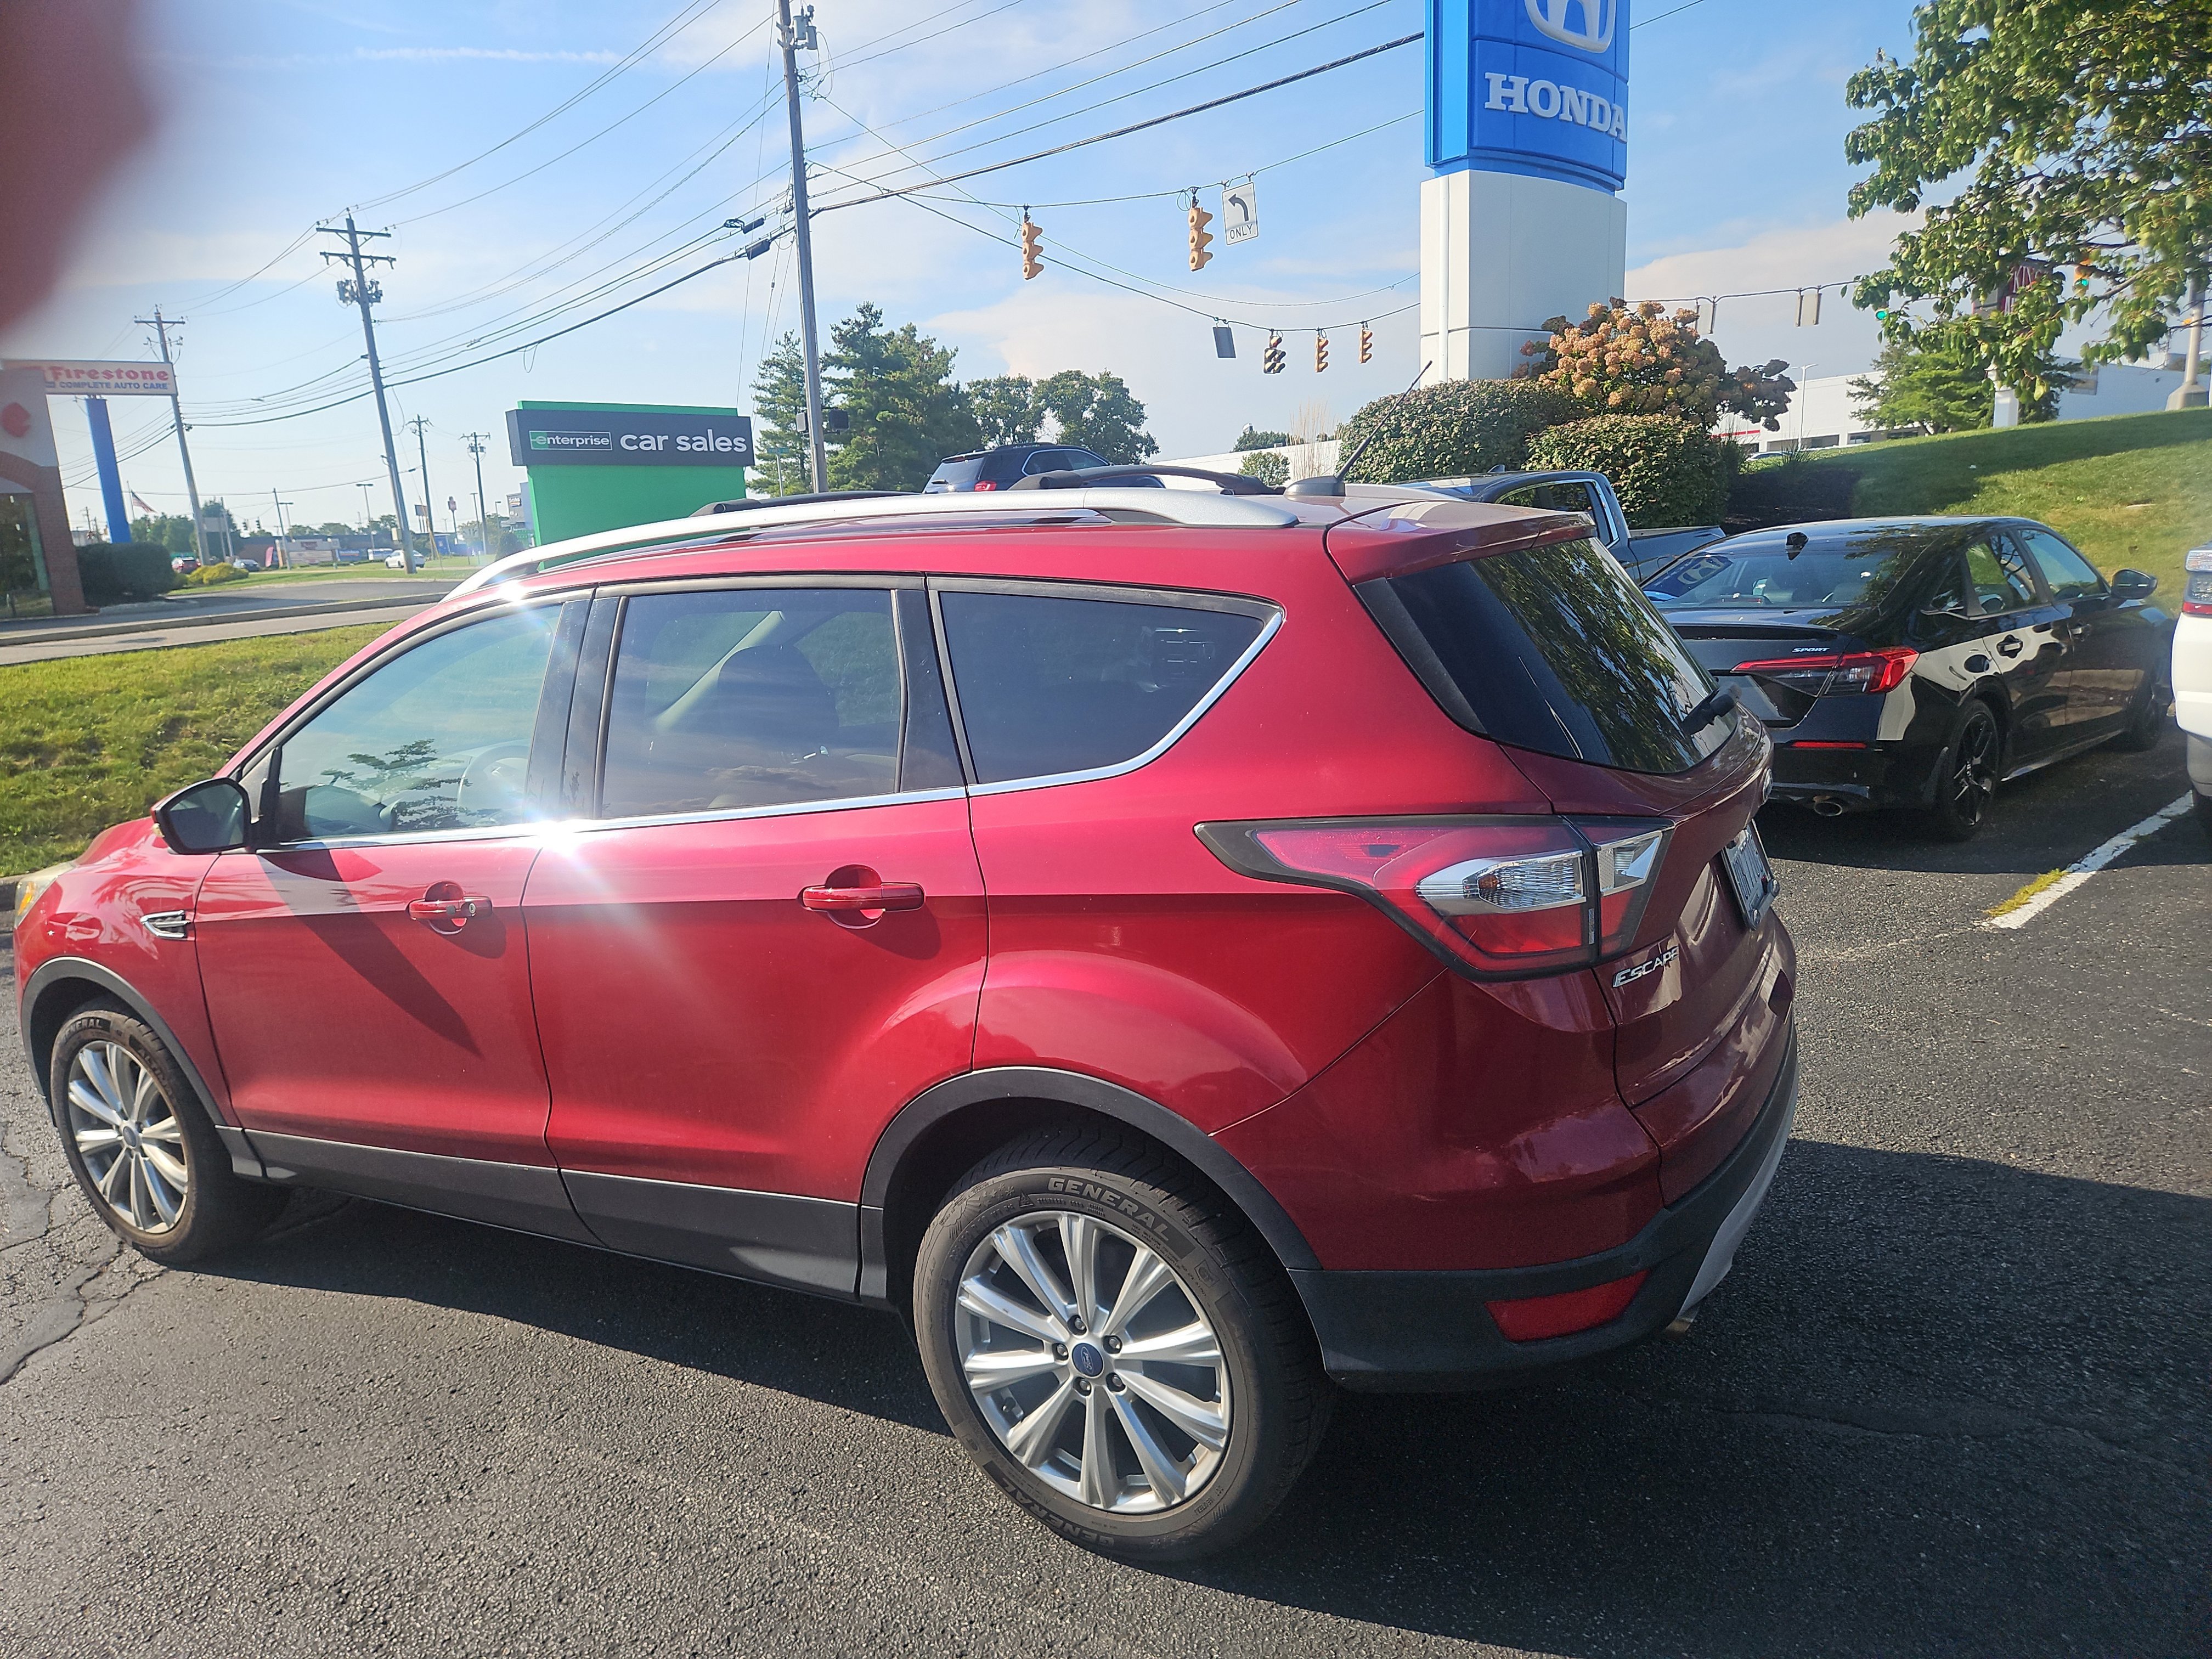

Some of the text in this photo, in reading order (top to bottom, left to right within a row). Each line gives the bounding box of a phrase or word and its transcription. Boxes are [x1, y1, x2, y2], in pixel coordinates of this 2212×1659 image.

[1485, 72, 1628, 144] HONDA
[1229, 223, 1253, 240] ONLY
[49, 365, 169, 381] Firestone
[535, 429, 748, 453] enterprise car sales
[1613, 946, 1679, 988] ESCAPE
[1047, 1177, 1170, 1242] GENERAL
[1002, 1477, 1115, 1545] GENERAL
